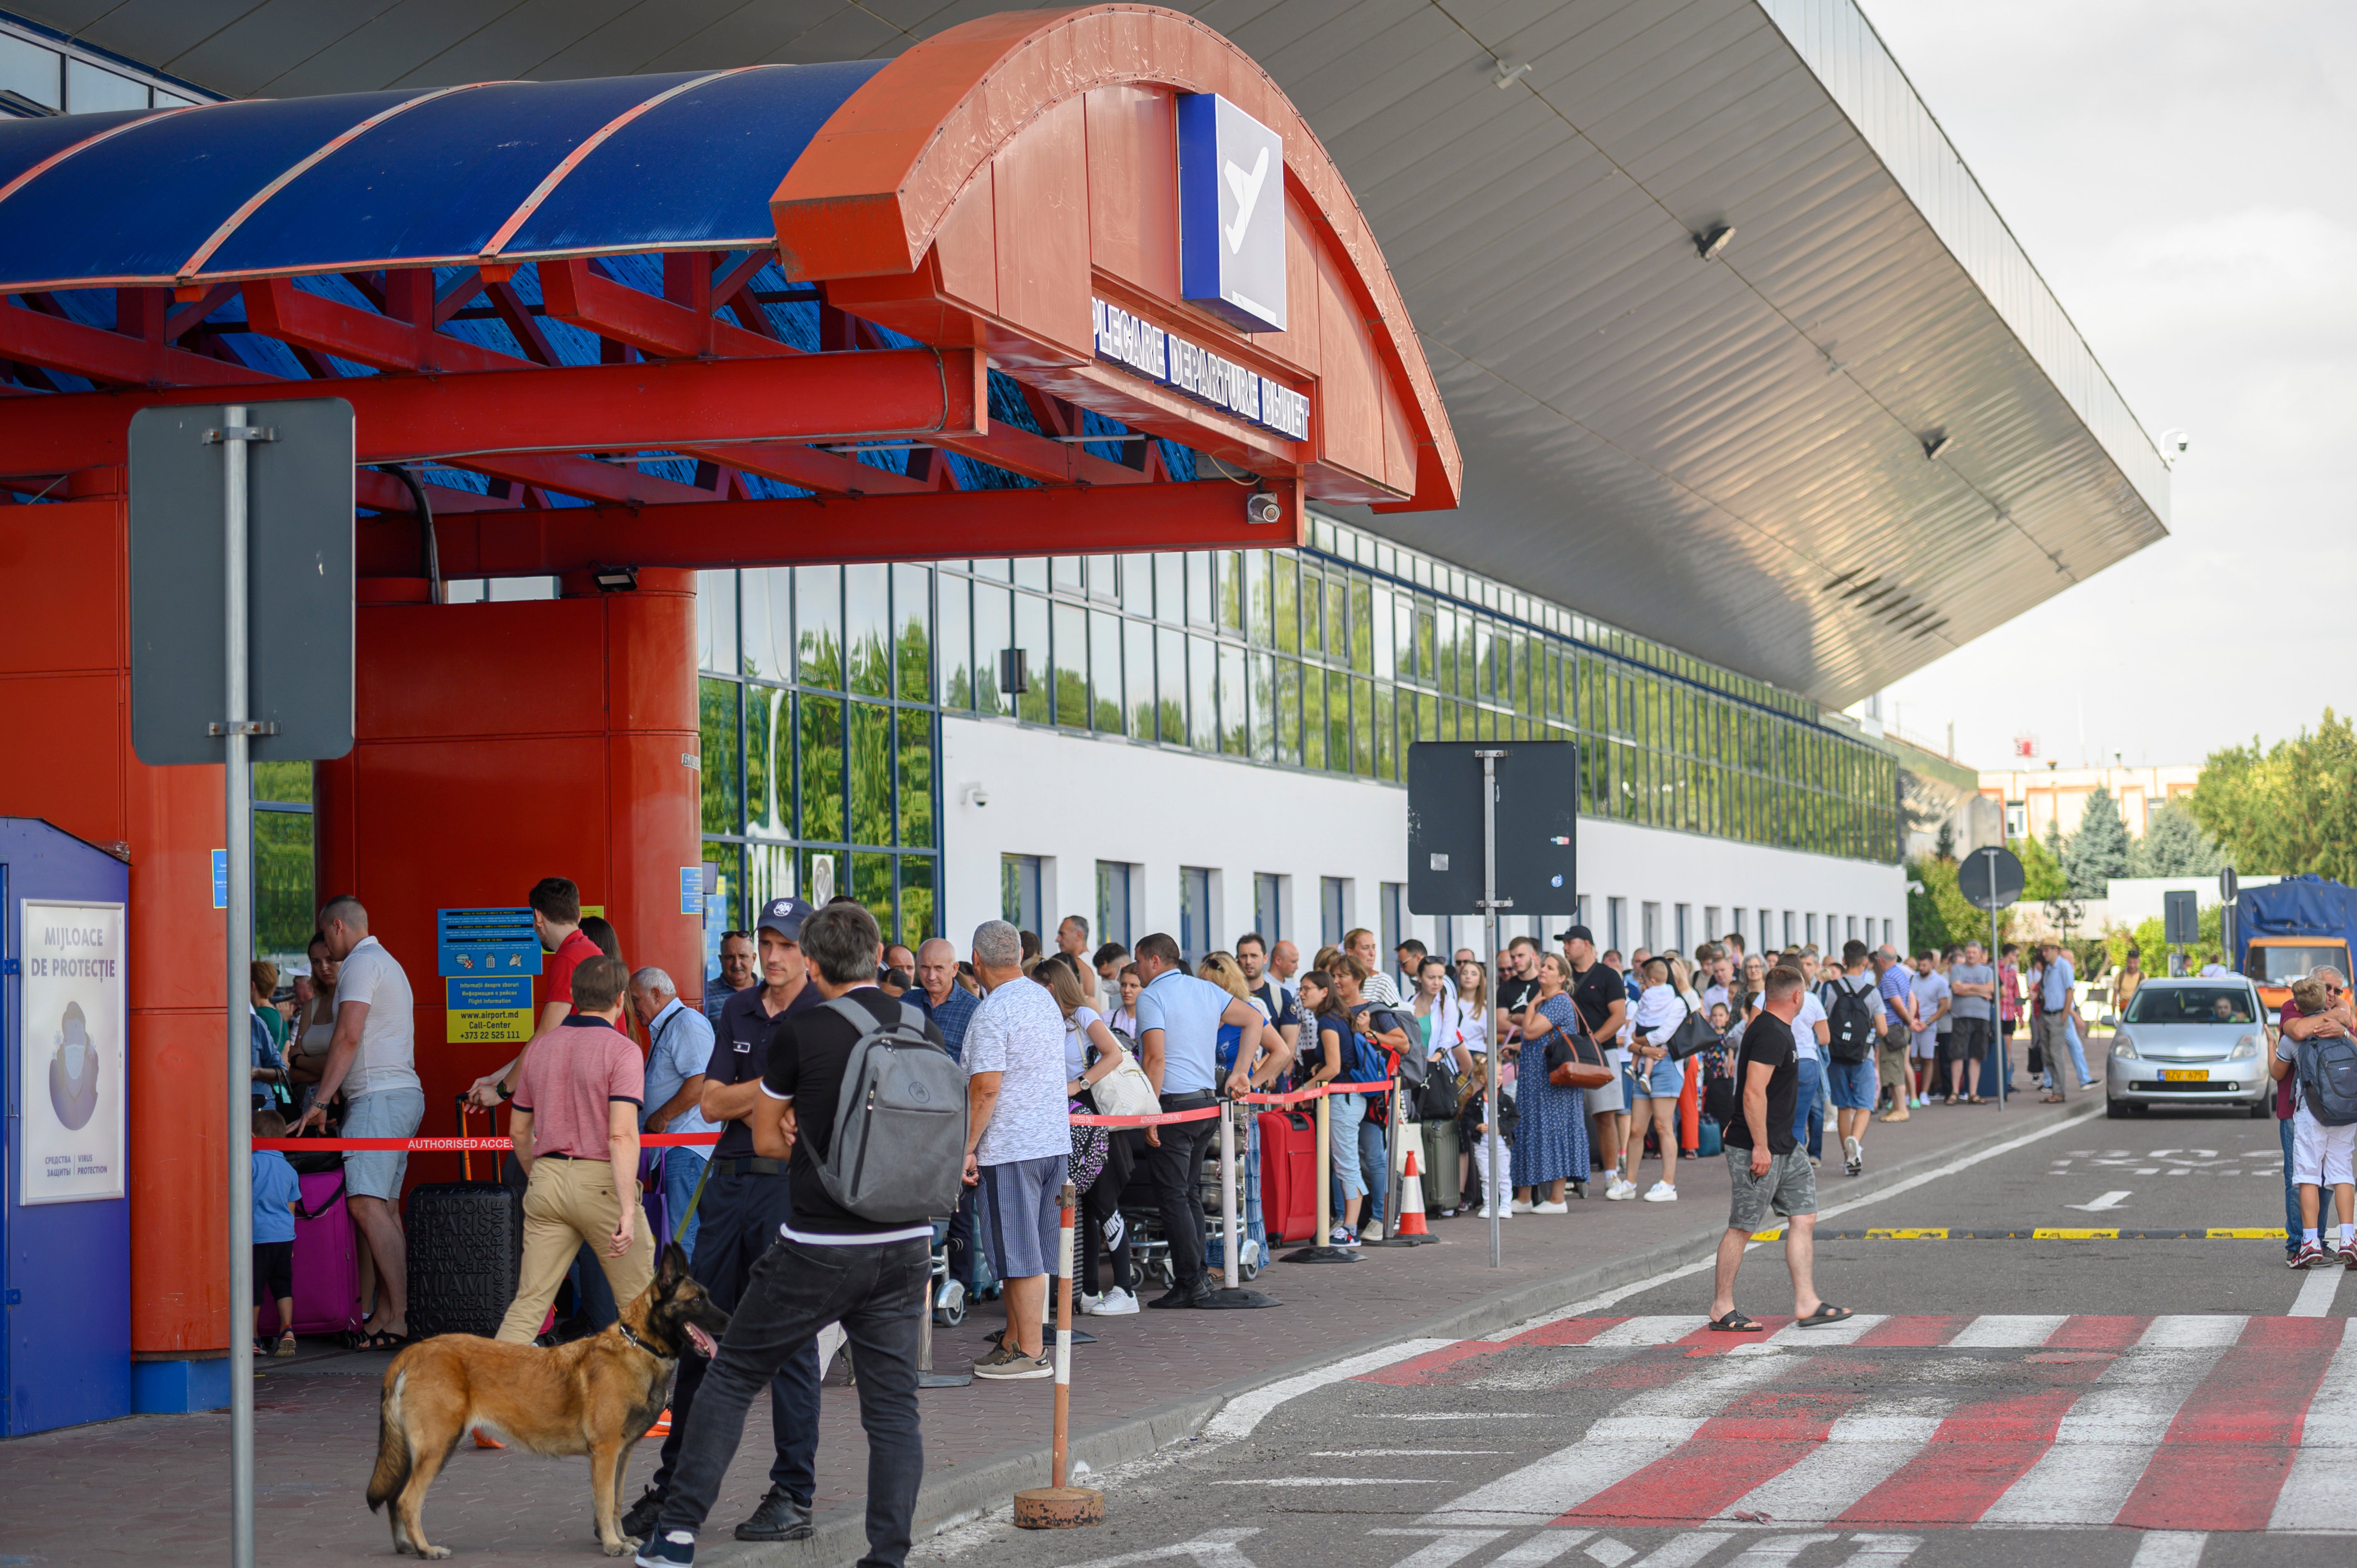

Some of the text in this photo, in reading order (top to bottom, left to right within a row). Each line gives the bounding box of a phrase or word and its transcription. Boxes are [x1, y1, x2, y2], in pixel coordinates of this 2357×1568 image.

[1092, 296, 1260, 421] PLECARE DEPARTURE
[1262, 377, 1309, 442] ВЫЛЕТ
[45, 927, 103, 950] MIJLOACE
[31, 958, 115, 983] DE PROTECȚIE
[461, 1011, 519, 1020] www.airport.md
[408, 1139, 514, 1148] AUTHORISED ACCES
[45, 1155, 71, 1165] СРЕДСТВА
[47, 1168, 71, 1177] ЗАЩИТЫ
[77, 1165, 108, 1175] PROTECTION
[418, 1199, 490, 1214] LONDON
[430, 1214, 492, 1235] PARIS
[491, 1201, 504, 1246] ROME
[1102, 1209, 1121, 1240] NIKE
[431, 1236, 491, 1247] NEW YORK
[430, 1247, 504, 1260] NEW YORK
[409, 1262, 492, 1274] LOS ANGELES
[420, 1275, 490, 1296] MIAMI
[494, 1262, 505, 1320] JAMAICA
[420, 1297, 492, 1310] MONTREAL
[411, 1313, 444, 1332] RIO
[476, 1322, 497, 1332] CAN
